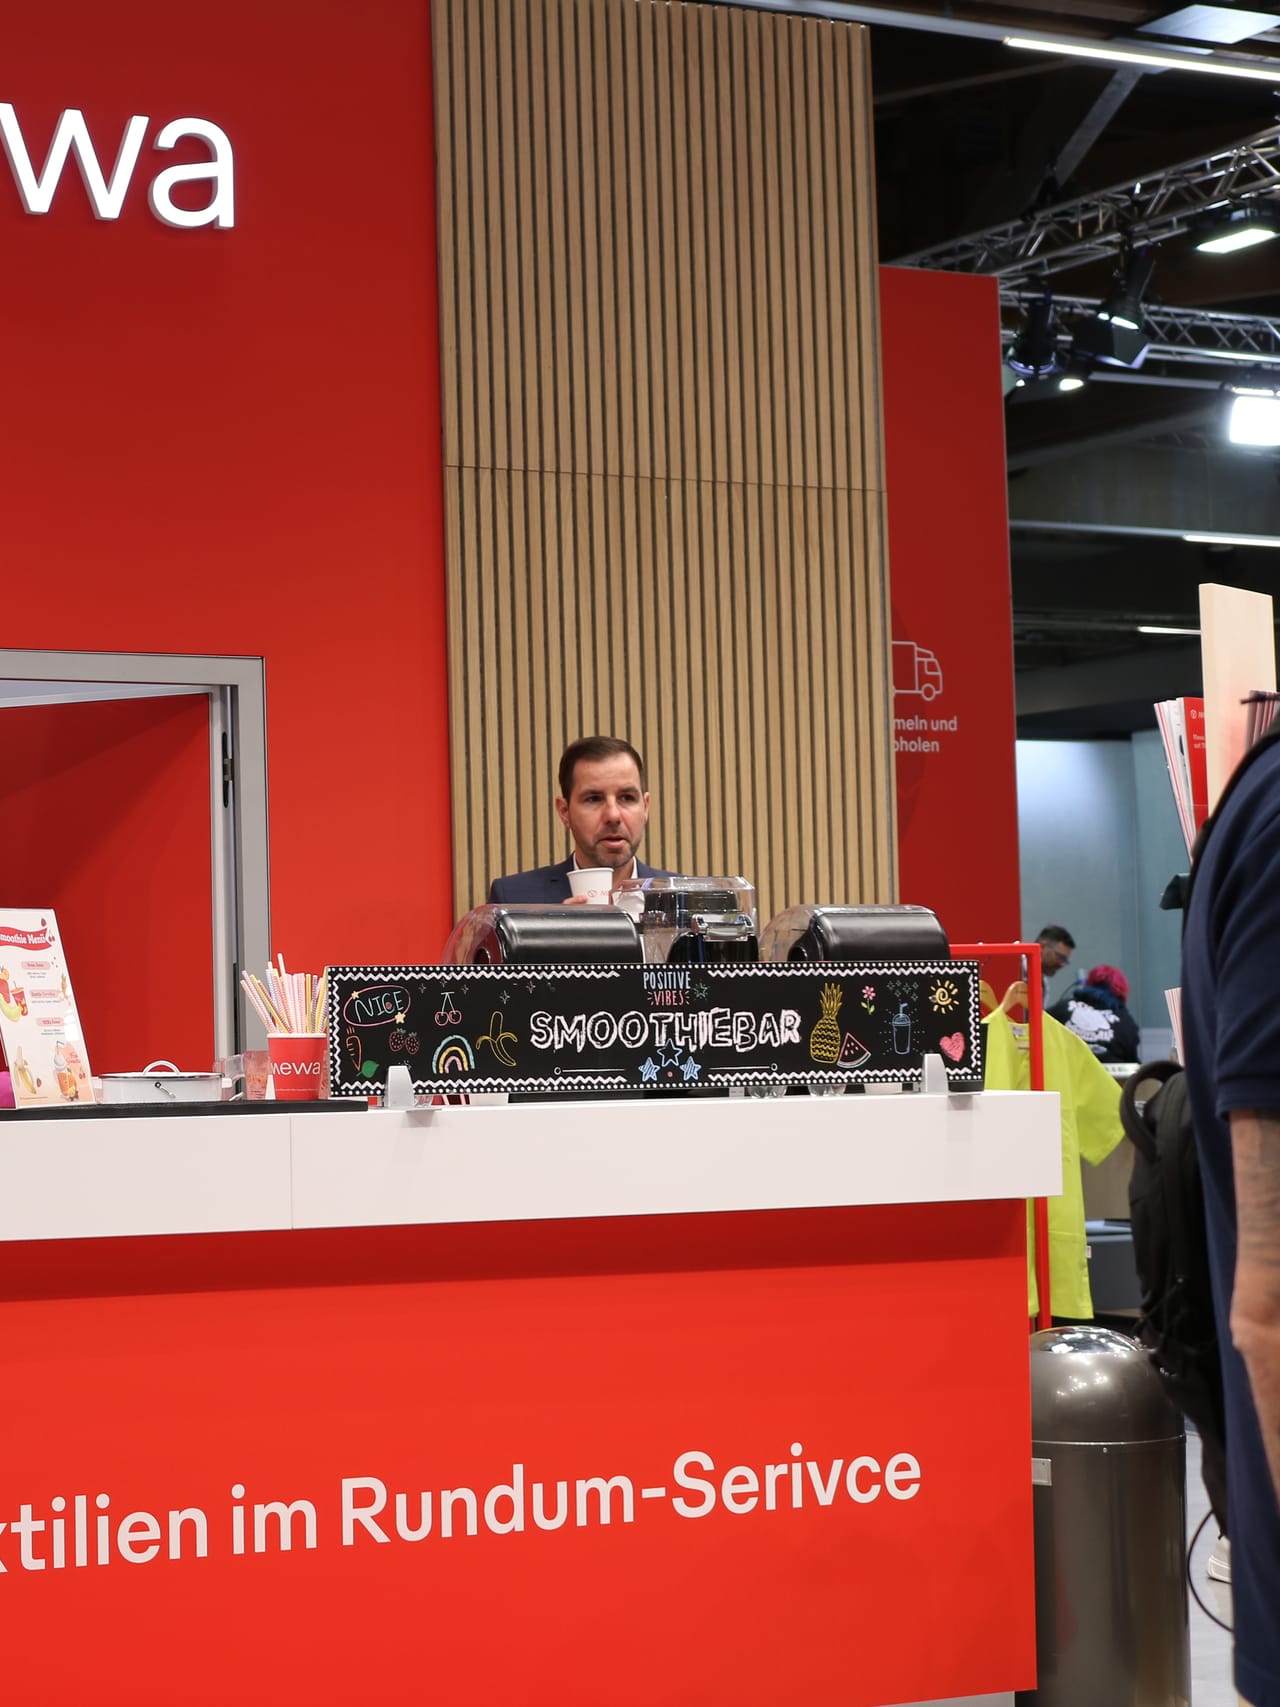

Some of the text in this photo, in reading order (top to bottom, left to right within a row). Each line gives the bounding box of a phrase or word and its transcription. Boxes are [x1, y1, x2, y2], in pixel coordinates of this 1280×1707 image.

[894, 714, 958, 732] meln und
[894, 736, 940, 753] holen
[643, 971, 691, 990] POSITIVE
[354, 990, 405, 1023] NICE
[652, 989, 685, 1007] VIBES
[529, 1007, 802, 1054] SMOOTHIEBAR
[232, 1483, 318, 1555] im
[341, 1442, 922, 1546] Rundum-Serivce
